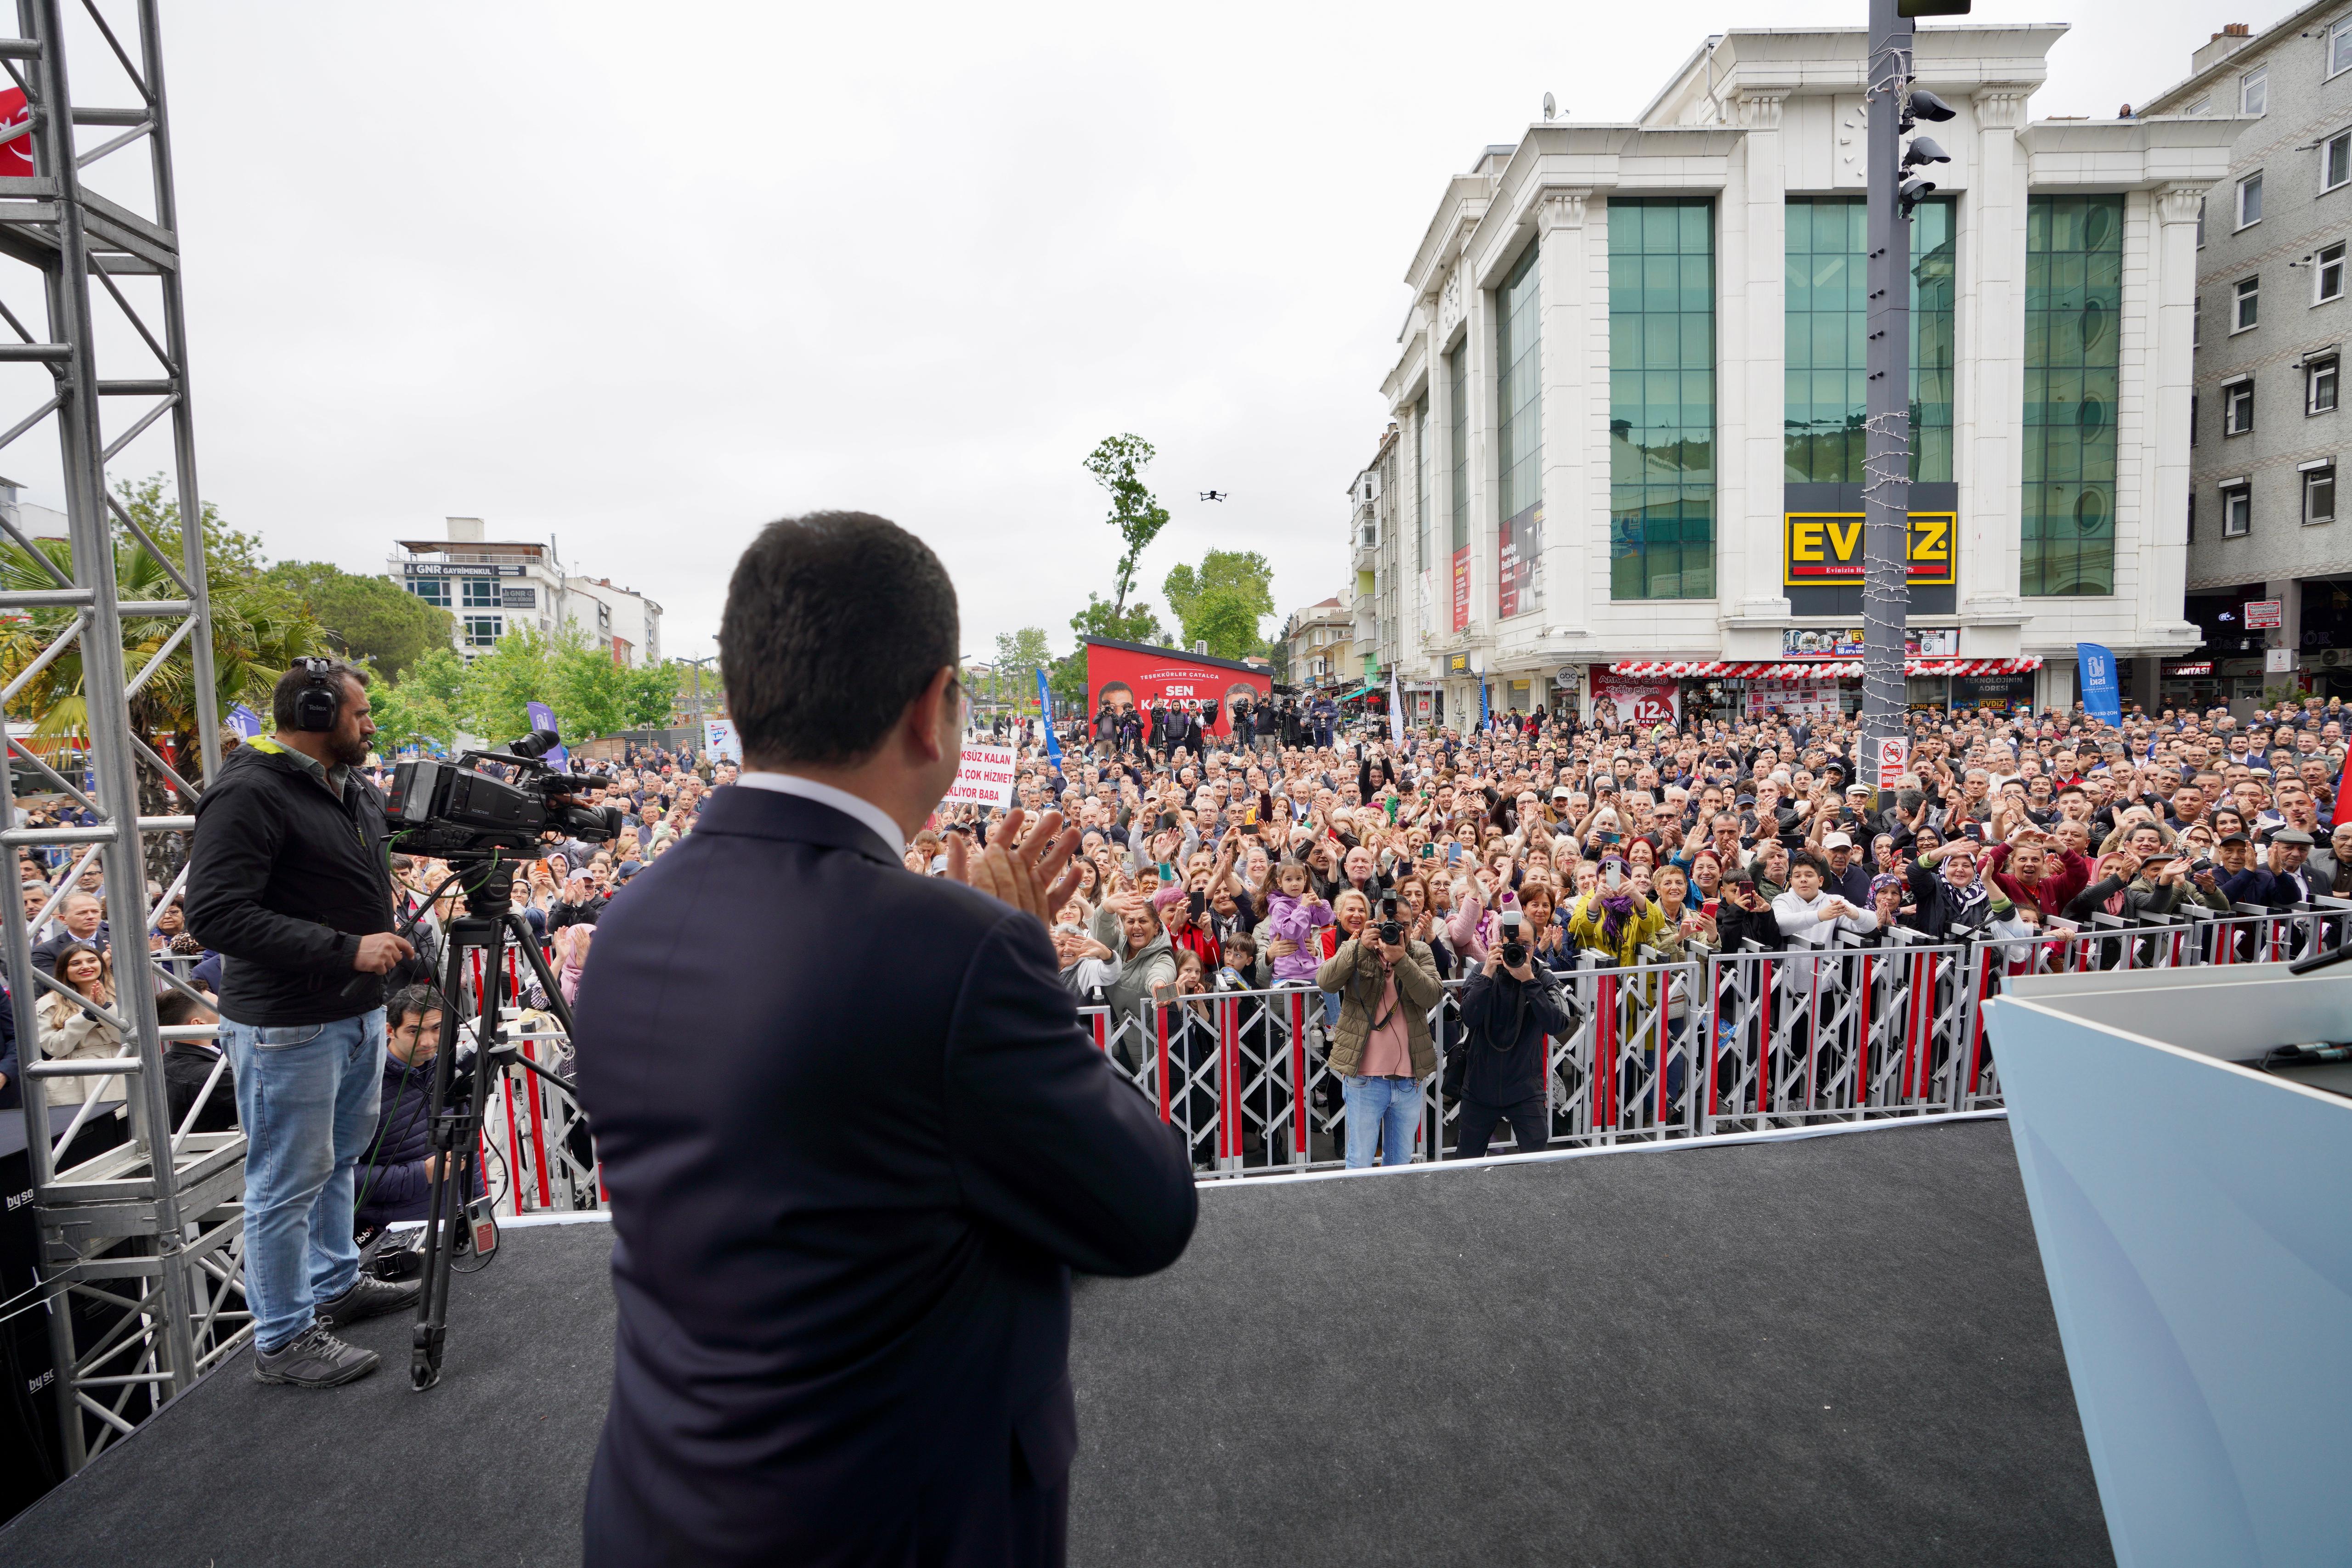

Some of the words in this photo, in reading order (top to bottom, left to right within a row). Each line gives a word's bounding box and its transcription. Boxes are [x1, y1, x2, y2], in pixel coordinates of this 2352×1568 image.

[1793, 522, 1947, 560] EVZ
[1501, 543, 1516, 558] Mobilya
[417, 564, 441, 574] GNR
[443, 566, 492, 575] GAYRİMENKUL
[1501, 555, 1520, 570] Evdiz'den
[1140, 671, 1187, 680] TEŞEKKÜRLER
[1599, 675, 1640, 684] Anneler
[1964, 676, 2023, 684] TEKNOLOJİNİN
[1165, 685, 1193, 696] SEN
[1606, 685, 1633, 694] Kutlu
[1634, 685, 1660, 694] Olsun
[1637, 701, 1659, 718] 12
[961, 750, 982, 762] KSÜZ
[984, 753, 1011, 765] KALAN
[965, 769, 982, 781] ÇOK
[984, 769, 1013, 784] HİZMET
[979, 789, 999, 801] BABA
[7, 1193, 20, 1209] by
[29, 1376, 42, 1391] by
